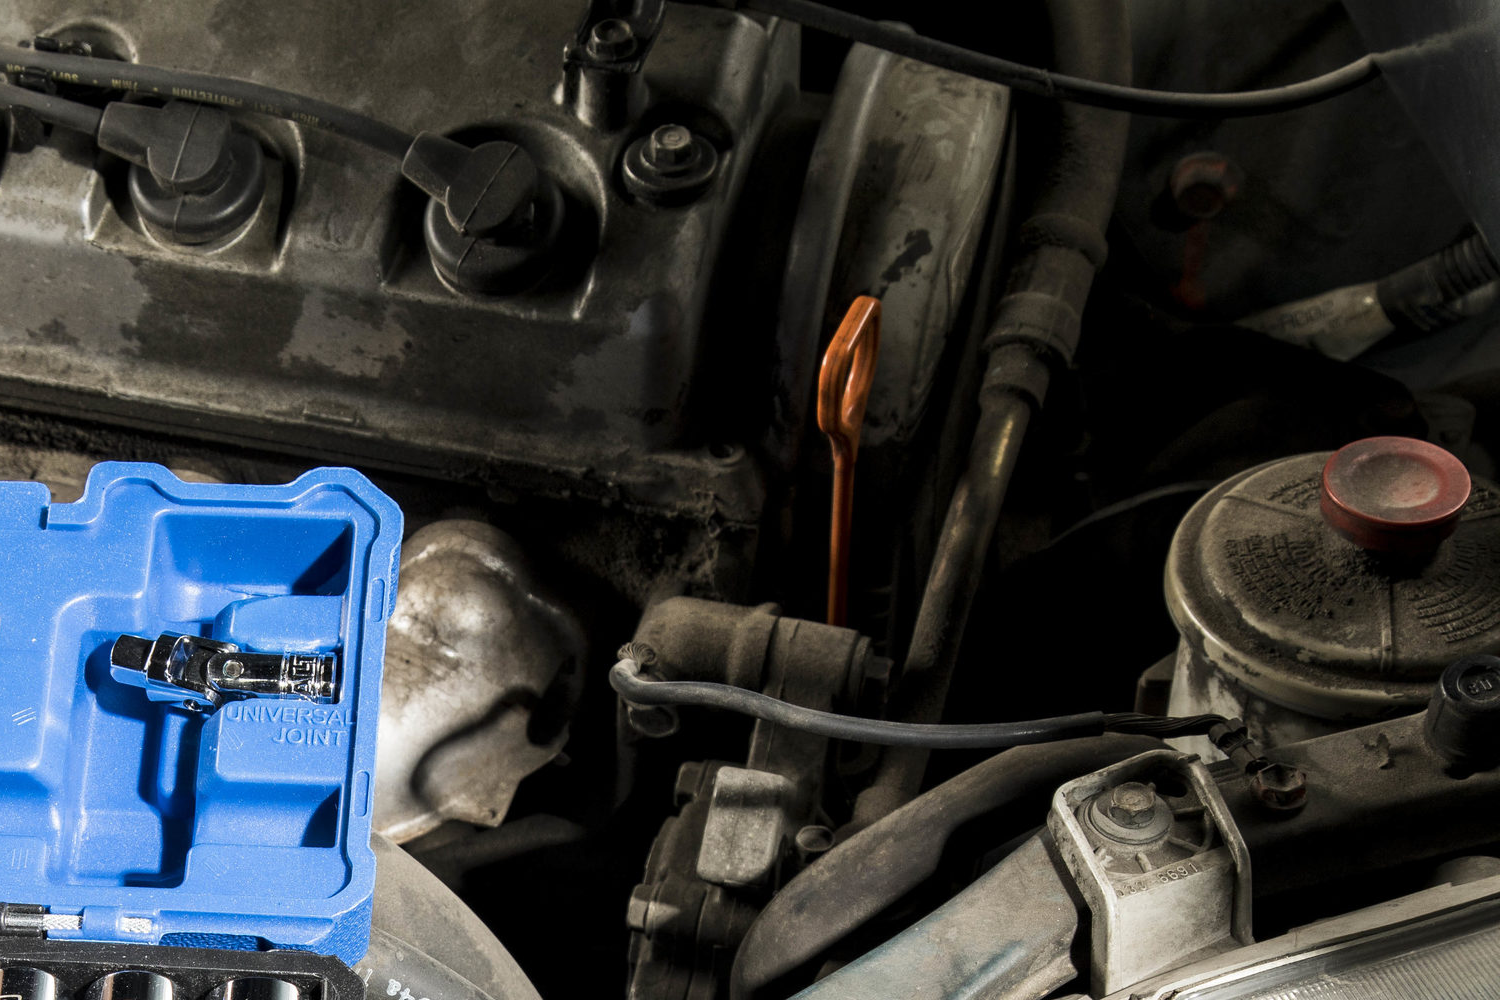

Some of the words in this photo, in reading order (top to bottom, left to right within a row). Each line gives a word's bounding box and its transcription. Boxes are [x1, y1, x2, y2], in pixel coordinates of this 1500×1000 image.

[172, 86, 244, 108] PROTECTION
[225, 705, 355, 727] UNIVERSAL
[272, 727, 348, 746] JOINT
